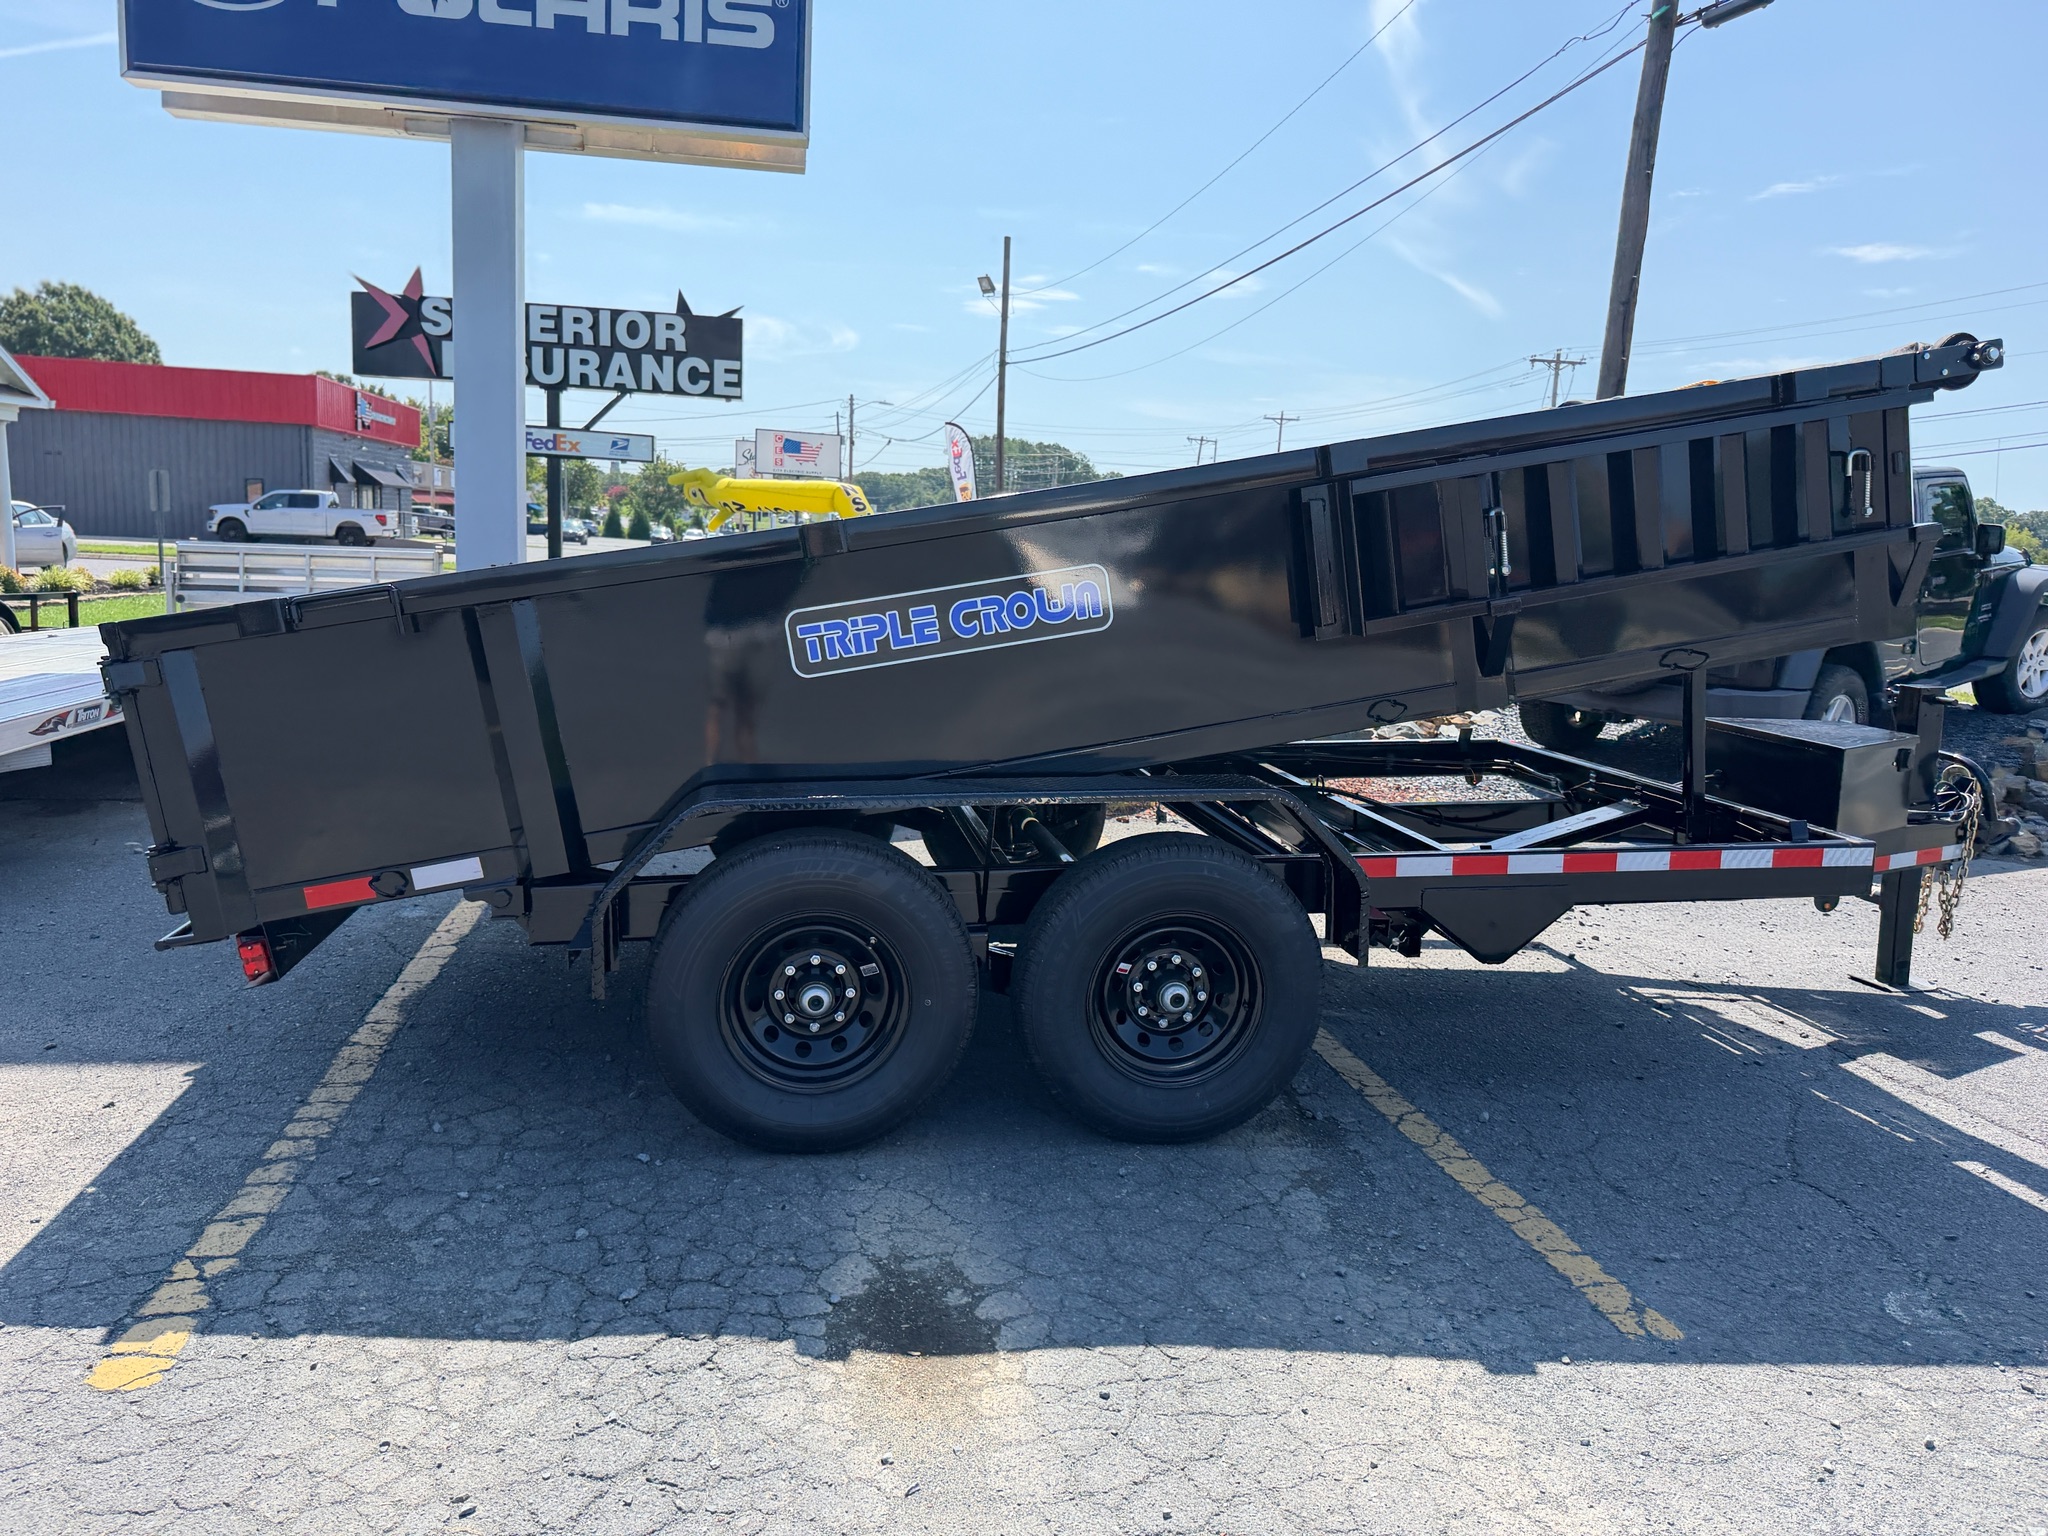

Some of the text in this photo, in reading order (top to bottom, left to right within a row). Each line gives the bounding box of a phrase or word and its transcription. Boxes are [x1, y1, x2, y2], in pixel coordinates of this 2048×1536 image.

[420, 297, 687, 352] SERIOR
[441, 339, 742, 397] IURANCE
[526, 431, 581, 453] FedEx
[796, 580, 1104, 663] TRIPLE CROWN
